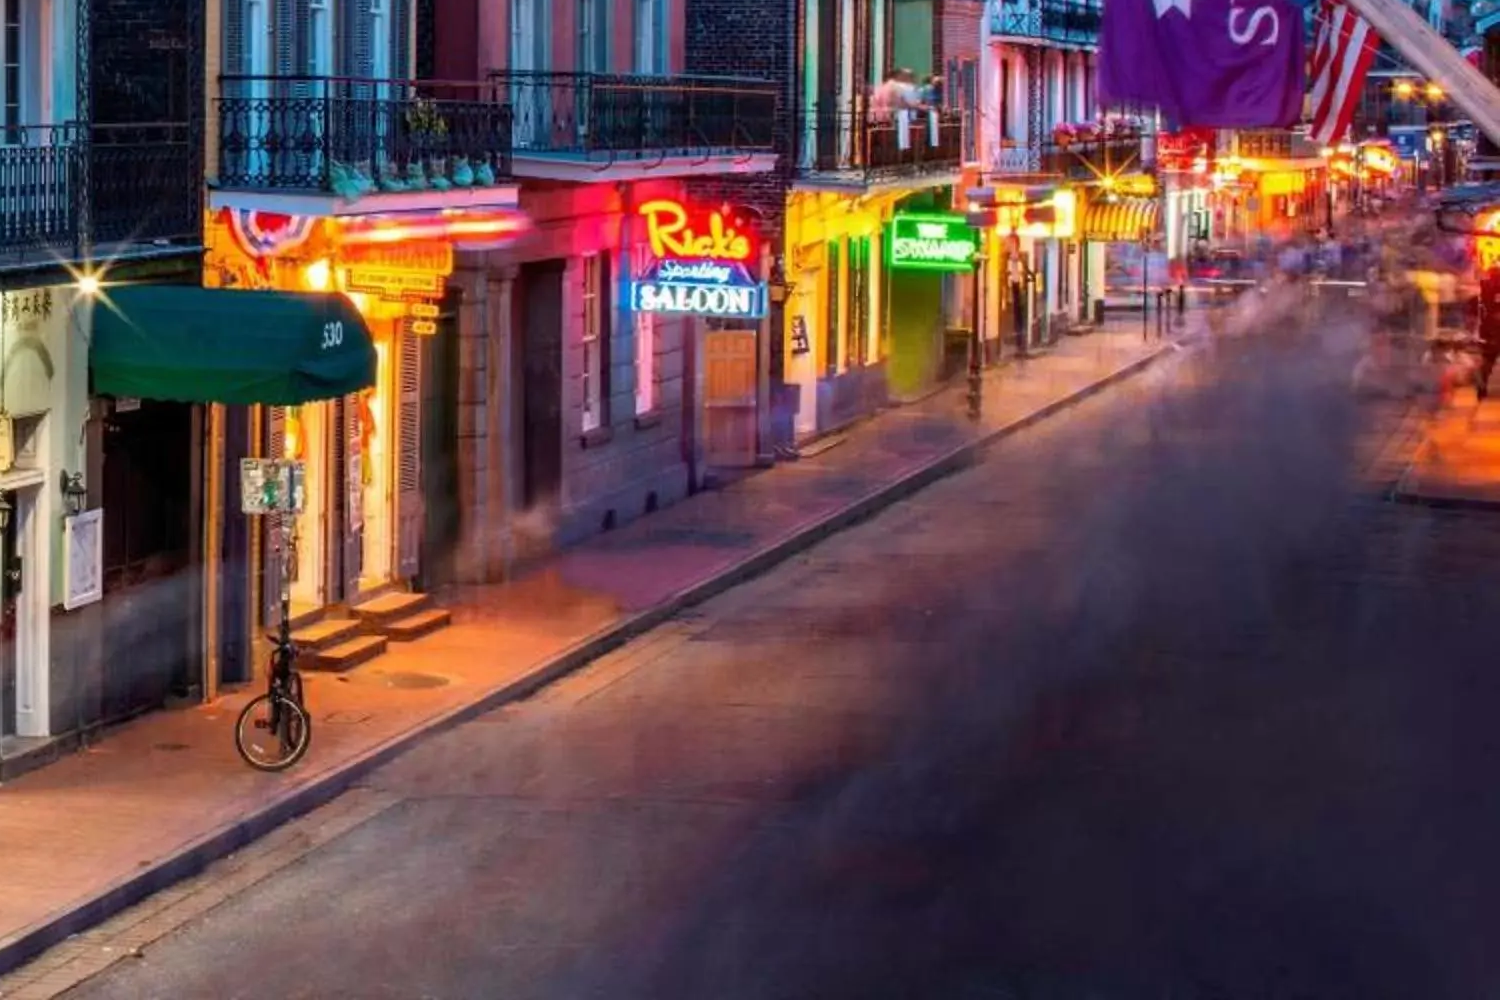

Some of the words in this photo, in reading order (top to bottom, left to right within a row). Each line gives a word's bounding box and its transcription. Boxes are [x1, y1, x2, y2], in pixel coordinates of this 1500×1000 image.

[639, 200, 750, 259] Rick's
[658, 260, 731, 282] Sporting
[641, 285, 750, 314] SALOON
